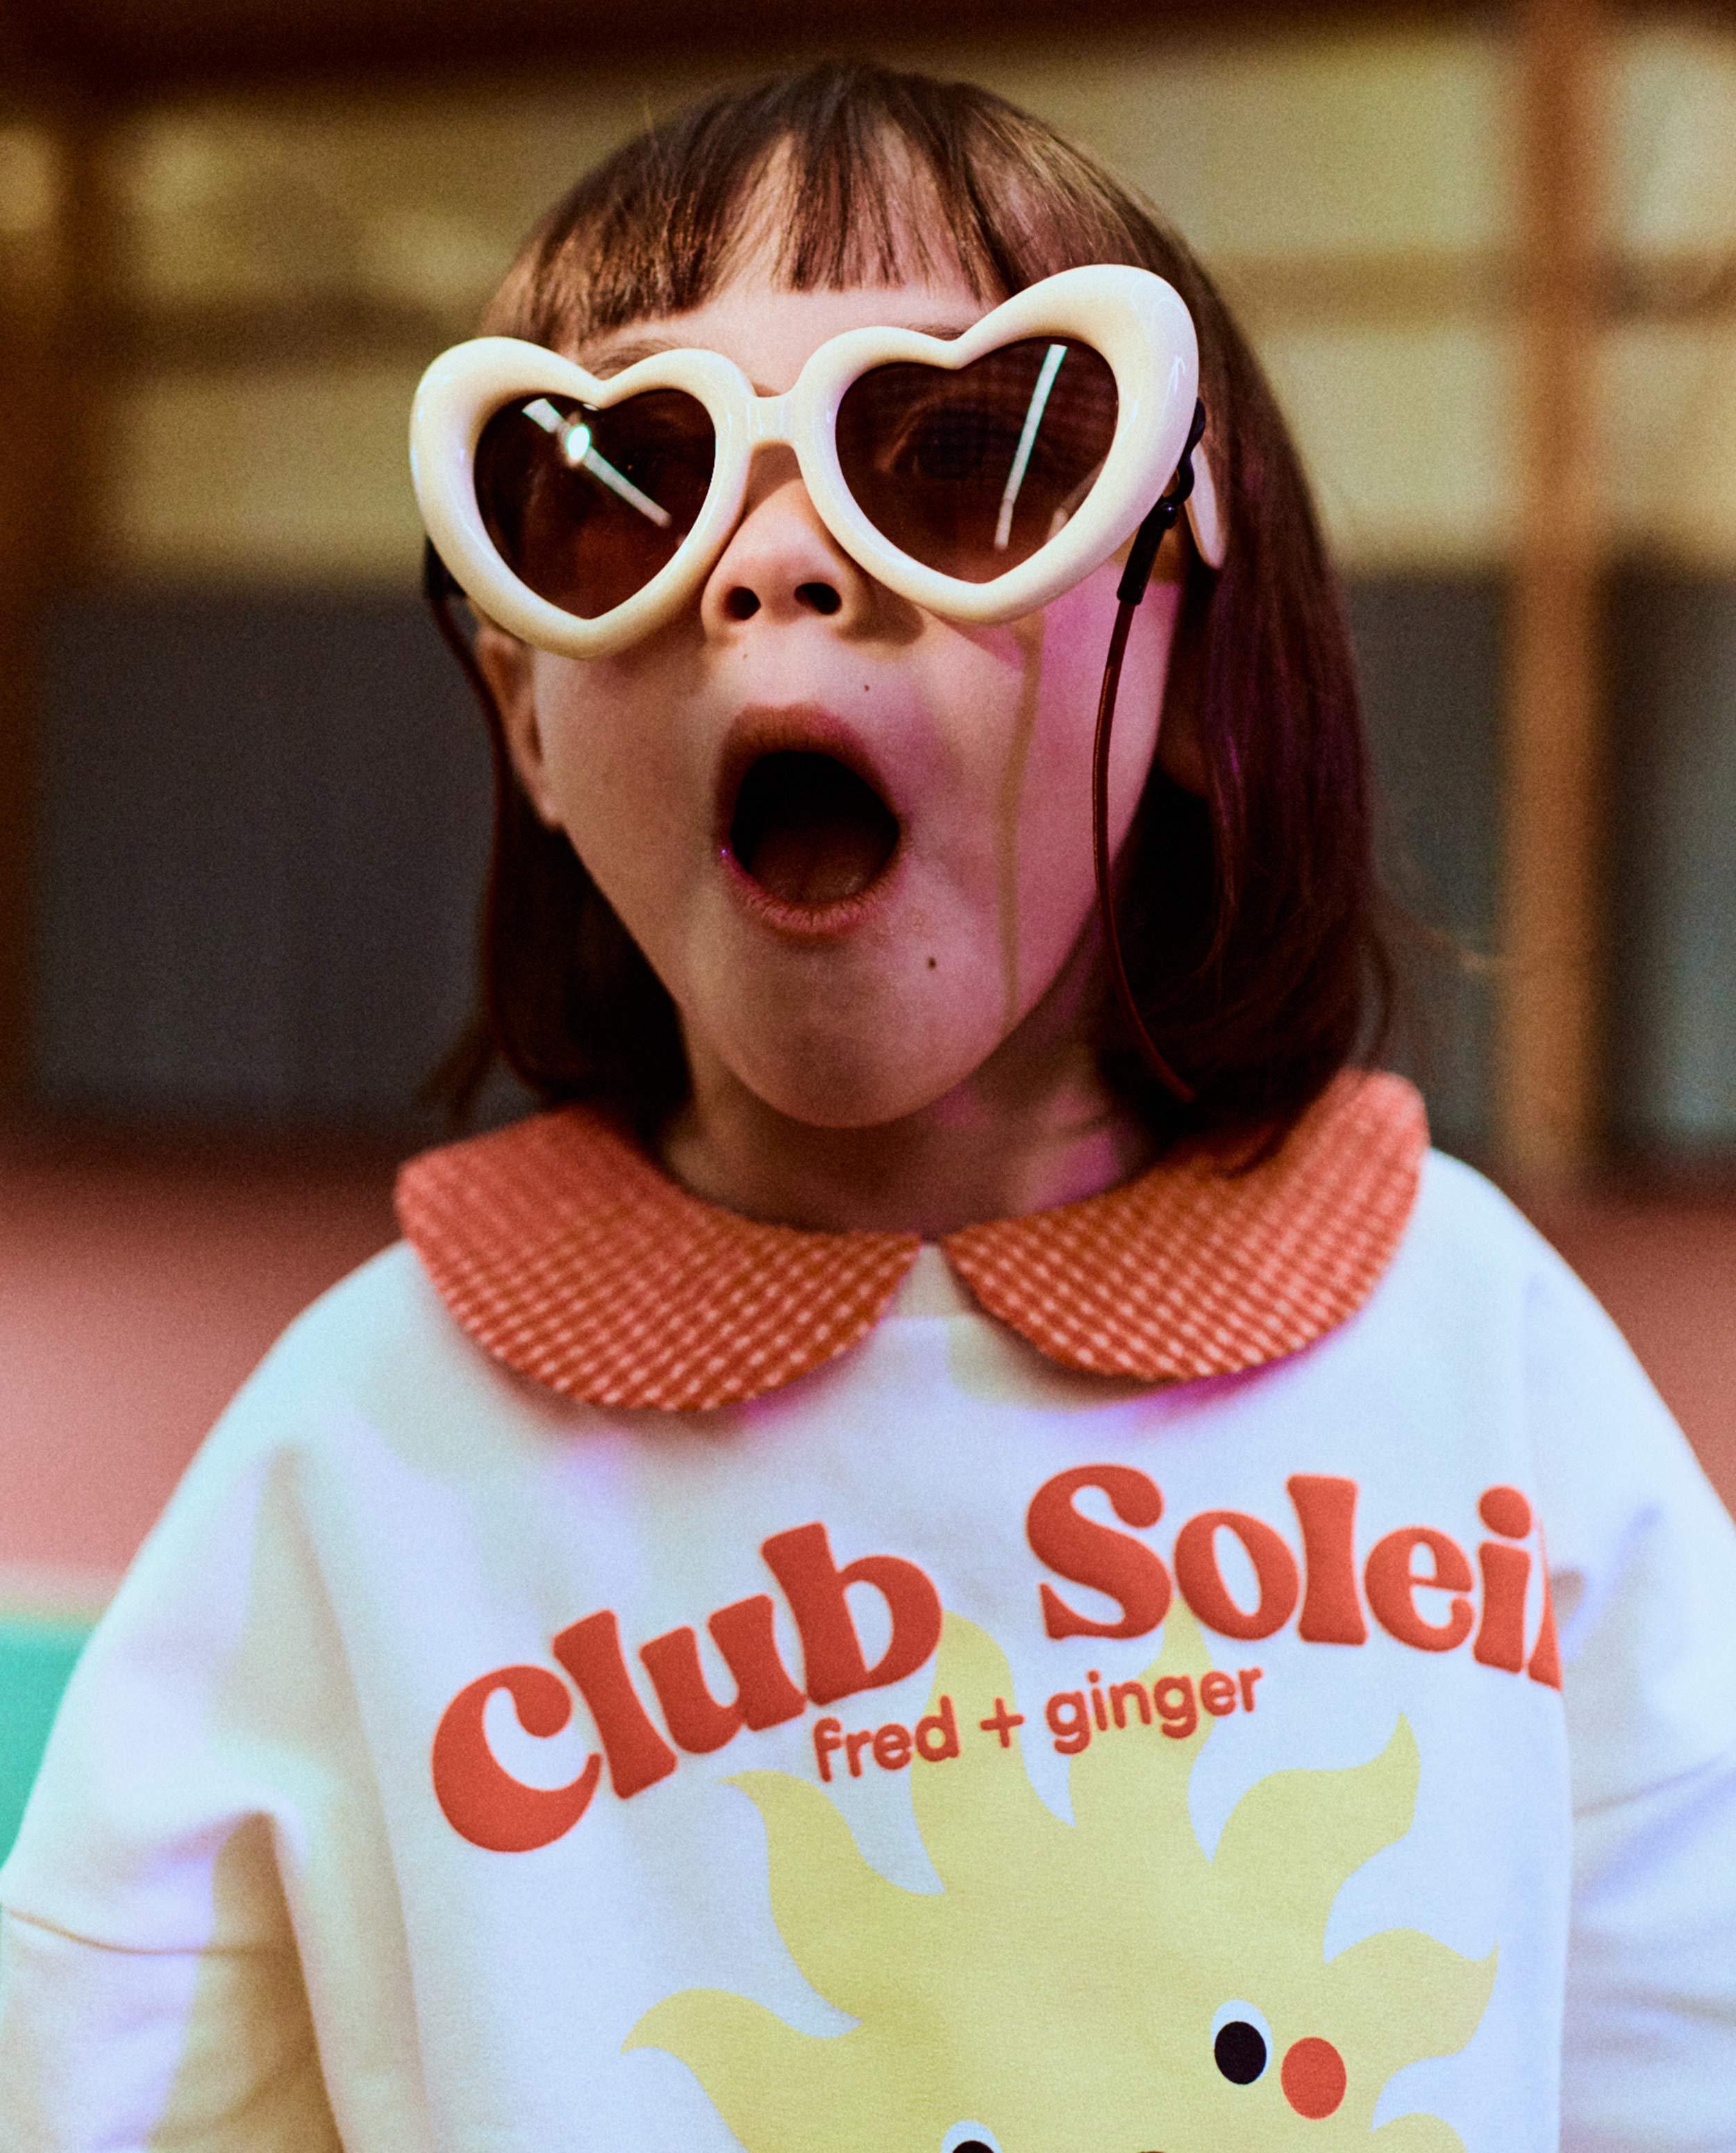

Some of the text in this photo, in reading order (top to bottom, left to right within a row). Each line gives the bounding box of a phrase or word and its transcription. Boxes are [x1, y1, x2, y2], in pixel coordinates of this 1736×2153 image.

[431, 1521, 943, 1853] Club
[812, 1667, 1263, 1783] fred + ginger
